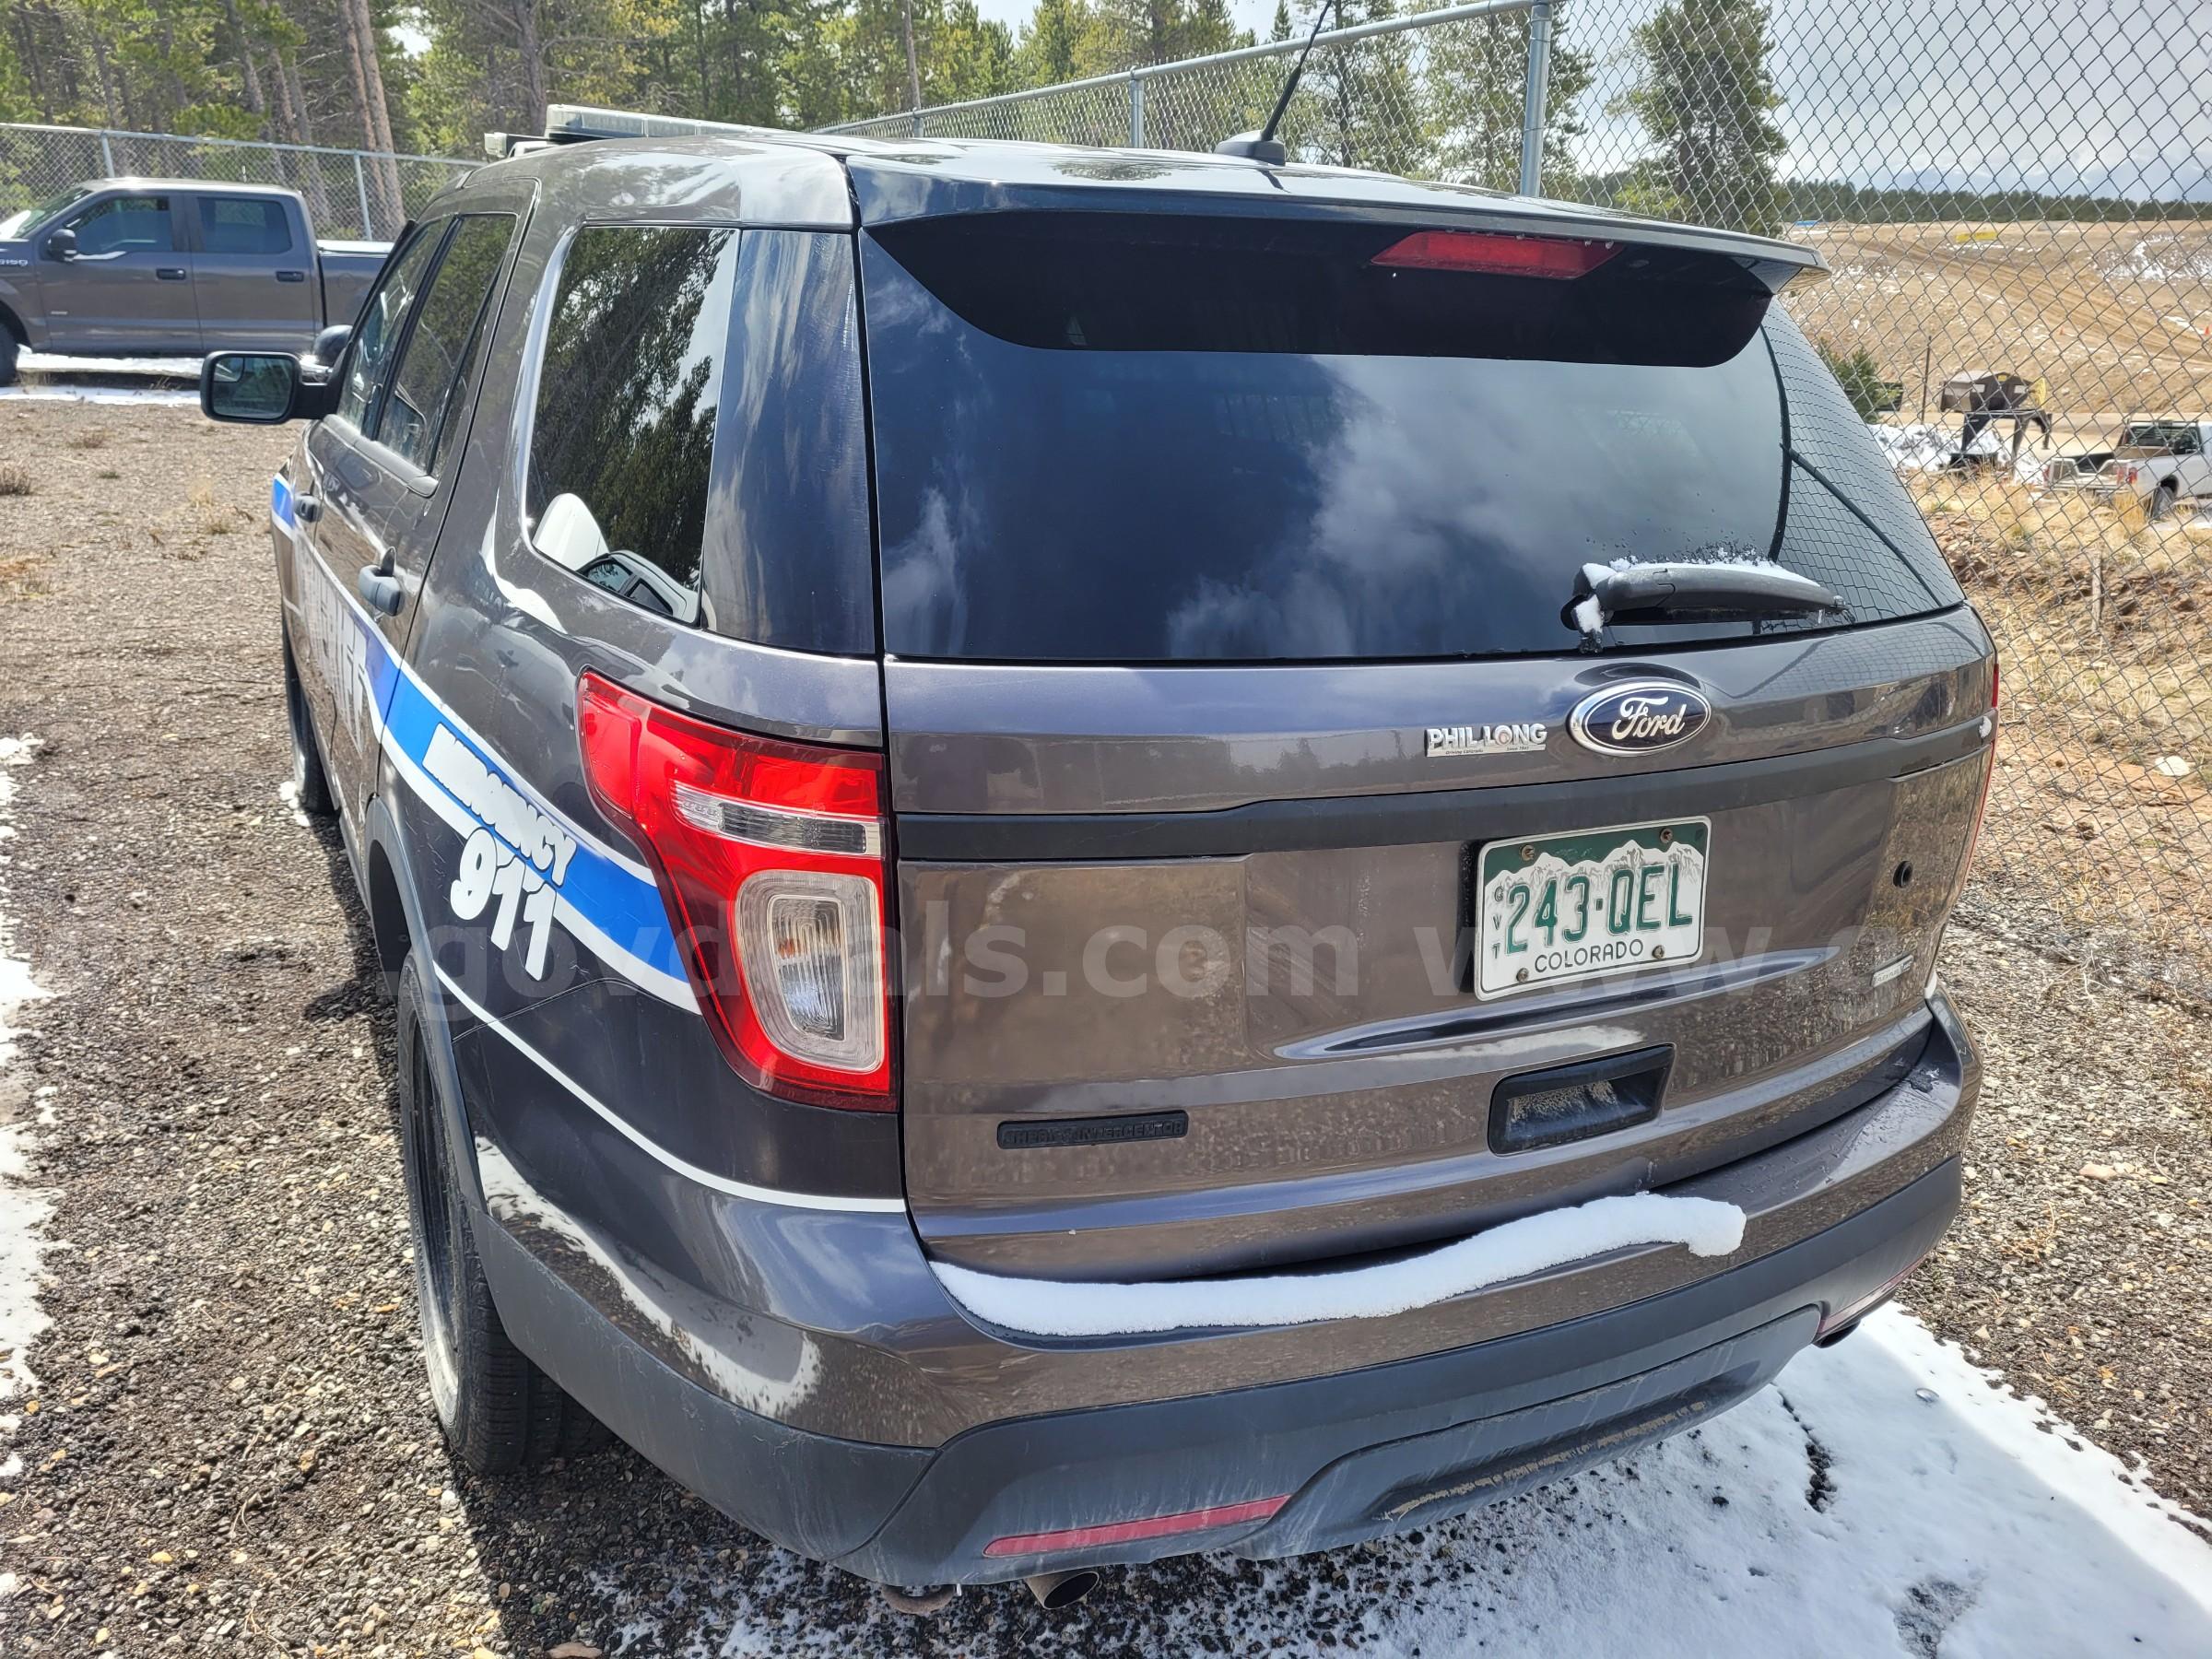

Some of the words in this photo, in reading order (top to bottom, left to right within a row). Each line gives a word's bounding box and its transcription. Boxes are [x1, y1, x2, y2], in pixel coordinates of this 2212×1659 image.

[1427, 726, 1478, 749] PHIL
[1482, 724, 1548, 747] LONG
[1612, 697, 1688, 740] Ford
[450, 829, 557, 982] 911
[1534, 938, 1644, 973] COLORADO
